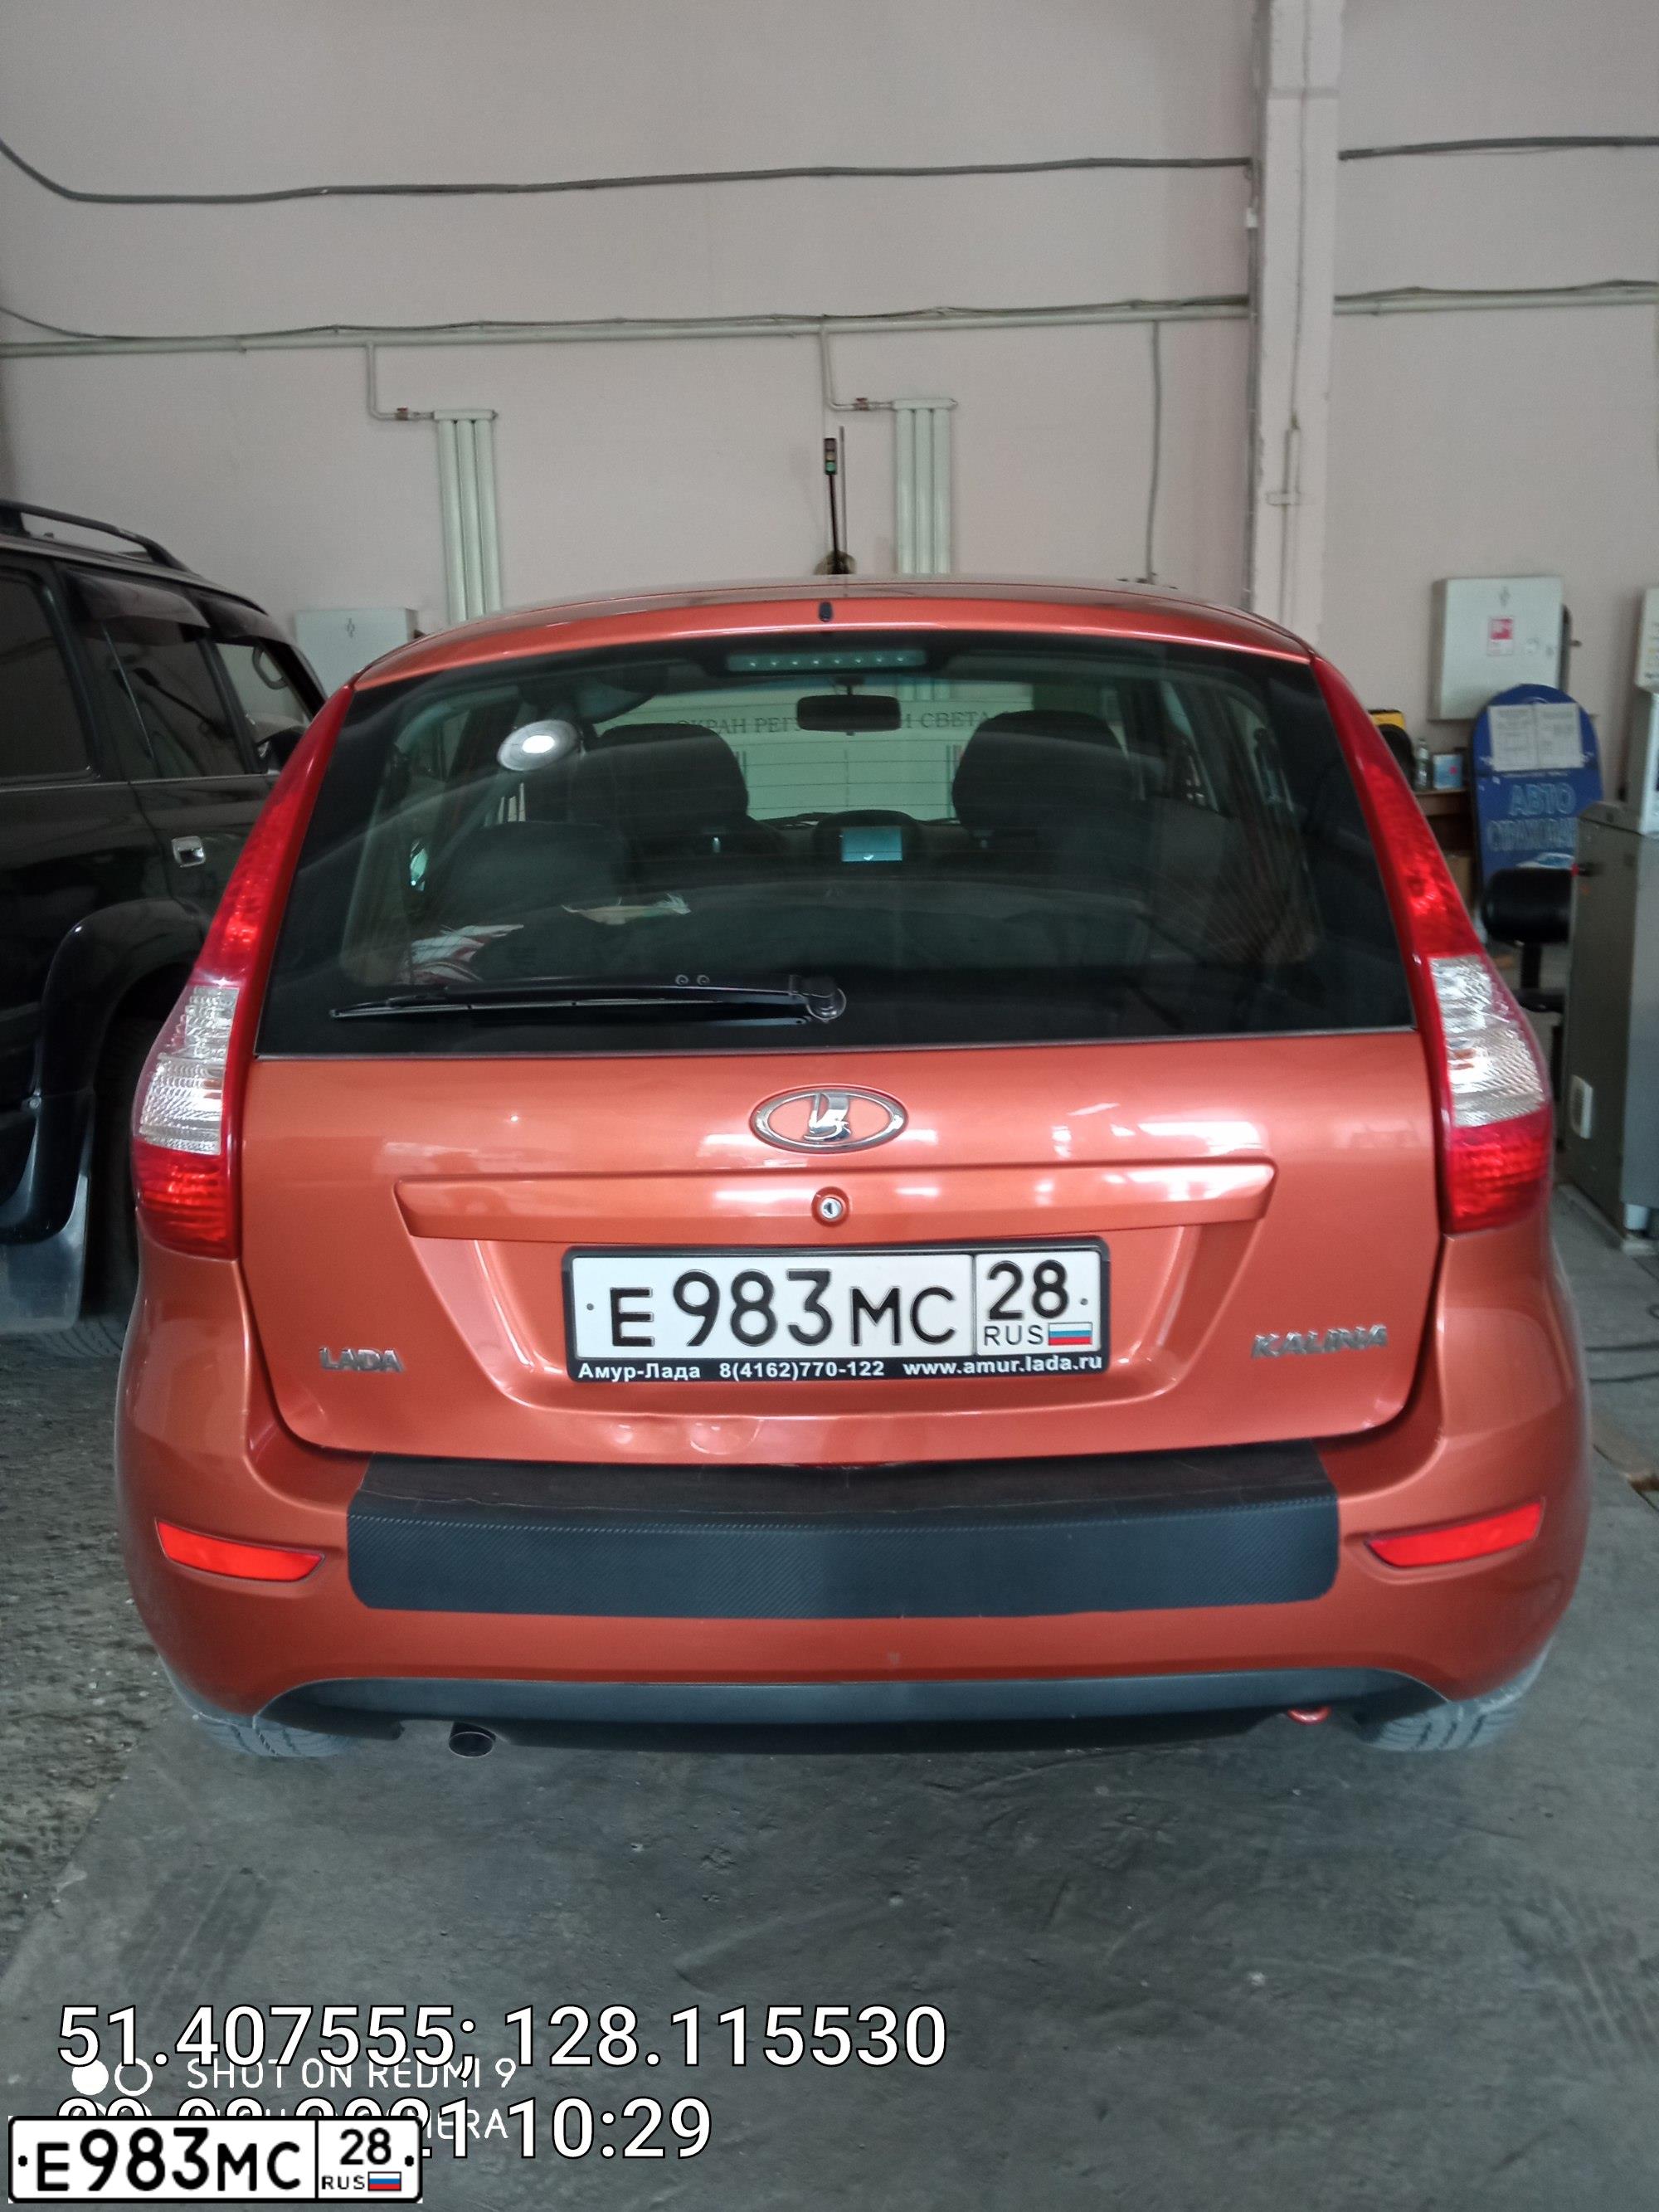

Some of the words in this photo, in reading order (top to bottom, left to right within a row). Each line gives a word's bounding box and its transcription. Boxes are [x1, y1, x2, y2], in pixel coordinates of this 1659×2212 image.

[987, 1259, 1069, 1320] 28
[984, 1324, 1045, 1345] RUS
[1251, 1324, 1388, 1358] KALINA
[319, 1347, 405, 1372] LADA
[578, 1363, 701, 1381] Амур-Лада
[719, 1360, 885, 1380] 8(4162)770-122
[902, 1355, 1102, 1376] www.amur.lada.ru
